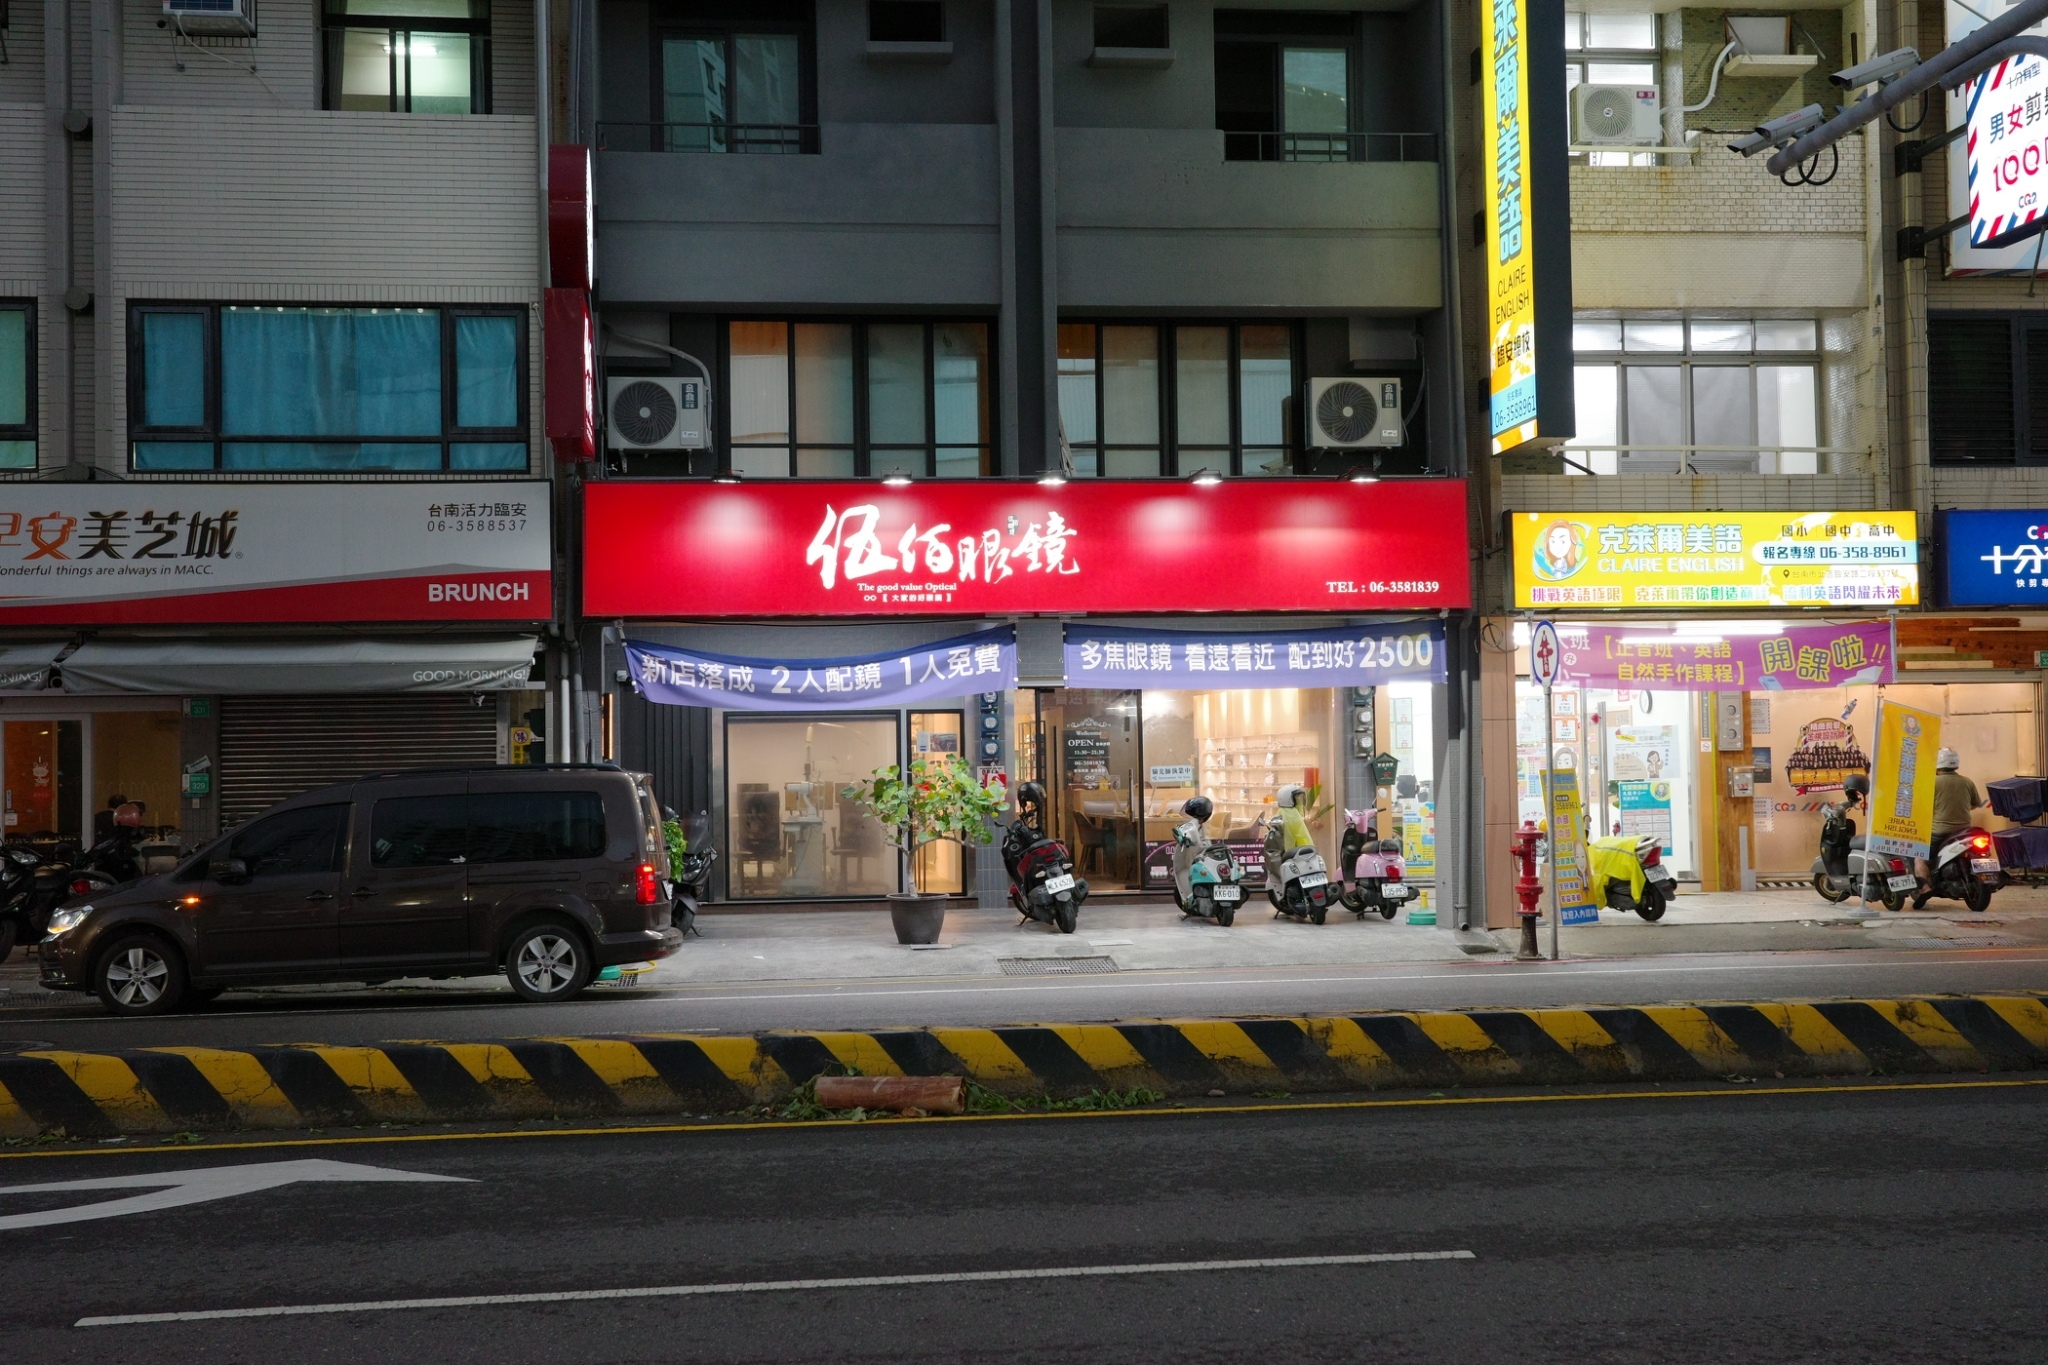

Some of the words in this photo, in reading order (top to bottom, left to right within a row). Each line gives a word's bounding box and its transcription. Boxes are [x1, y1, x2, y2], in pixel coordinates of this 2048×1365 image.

[2006, 61, 2041, 90] 十分有型
[1993, 135, 2048, 193] 100
[1497, 264, 1526, 298] CLAIRE
[1496, 289, 1529, 325] ENGLISH
[1495, 394, 1536, 428] 06-3588961
[427, 503, 527, 517] 台南活力臨安
[427, 519, 527, 532] 06-3588537
[1782, 525, 1808, 537] 國小
[1825, 525, 1851, 537] 國中
[1868, 525, 1895, 537] 高中
[806, 503, 1080, 589] 伍佰眼鏡
[1597, 524, 1743, 554] 克萊爾美語
[1763, 546, 1816, 559] 報名專線
[1820, 546, 1906, 558] 06-358-8961
[1980, 544, 2048, 574] 十分
[56, 564, 93, 578] things
[96, 567, 115, 575] are
[117, 564, 157, 577] always
[160, 565, 171, 575] in
[174, 565, 214, 576] MACC.
[1597, 557, 1663, 573] CLAIRE
[1667, 557, 1744, 572] ENGLISH
[428, 582, 529, 602] BRUNCH
[857, 582, 875, 591] The
[877, 582, 899, 593] good
[900, 583, 923, 592] value
[925, 582, 957, 592] Optical
[1369, 581, 1439, 593] 06-3581839
[1532, 587, 1621, 602] 挑戰英語極限
[1784, 585, 1901, 600] 流利英語閃耀未來
[1080, 640, 1172, 672] 多焦眼鏡
[1184, 641, 1276, 673] 看遠看近
[413, 670, 455, 682] GOOD
[458, 669, 526, 681] MORNING!
[641, 655, 755, 693] 新店落成
[770, 663, 882, 695] 2人配鏡
[898, 643, 1001, 686] 1人免費
[1618, 661, 1744, 685] 自然手作課程】
